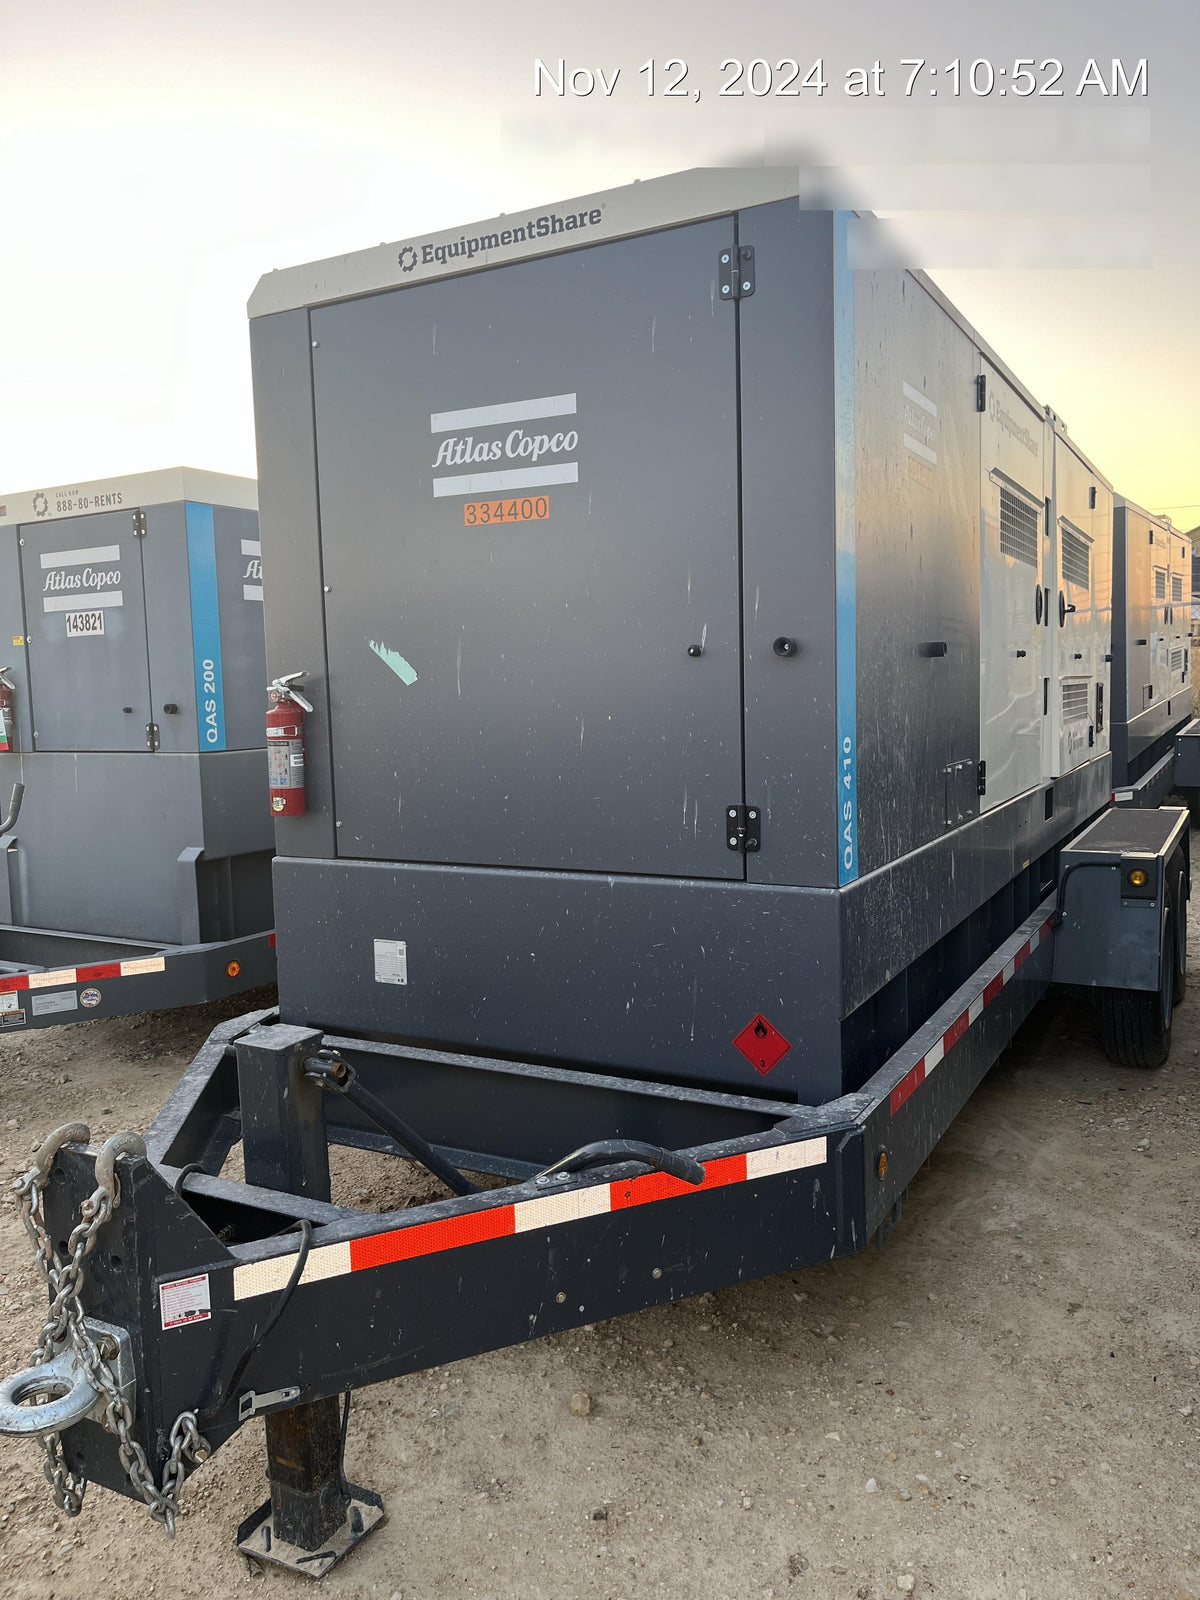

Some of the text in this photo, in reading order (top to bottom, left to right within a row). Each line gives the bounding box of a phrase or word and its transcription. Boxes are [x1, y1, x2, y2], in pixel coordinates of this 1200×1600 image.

[421, 208, 602, 265] EquipmentShare
[432, 429, 579, 468] Atlas Copco
[56, 492, 123, 512] 888-80-RENTS
[466, 497, 548, 524] 334400
[43, 568, 121, 592] Atlas Copco
[66, 612, 103, 633] 143821
[202, 659, 219, 744] QAS 200
[843, 736, 853, 870] QAS 410
[760, 1059, 766, 1068] 3
